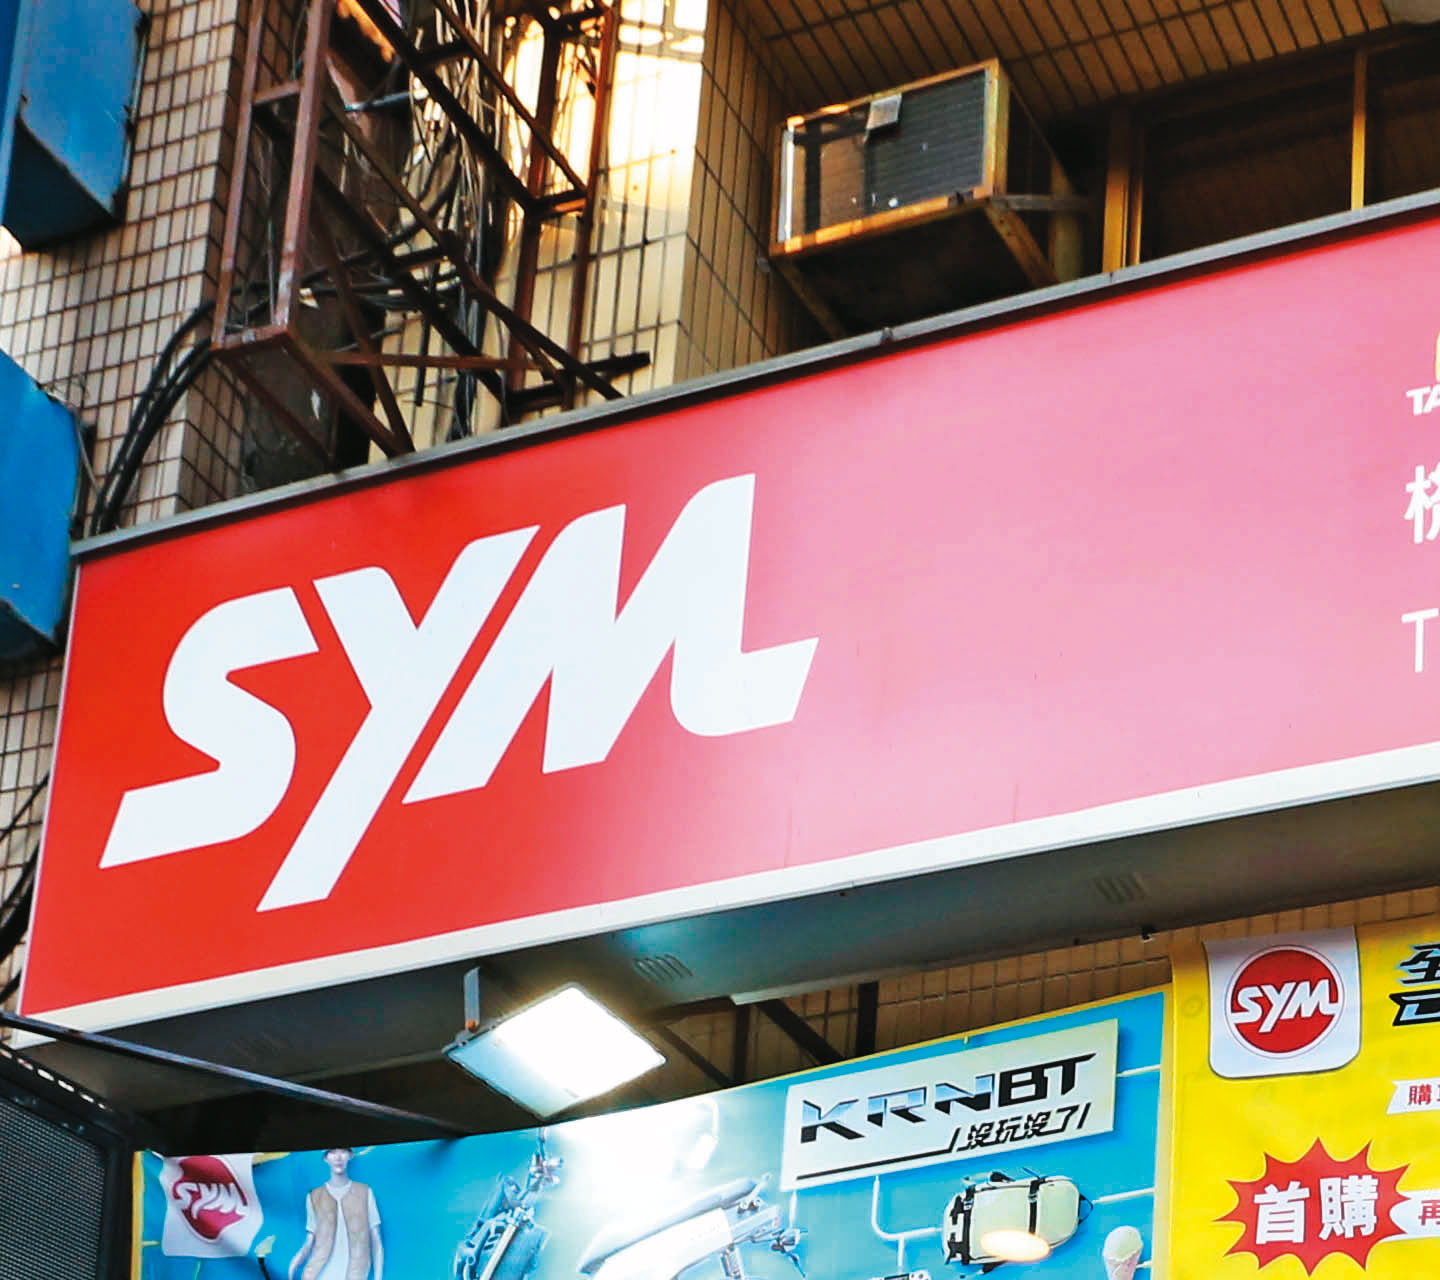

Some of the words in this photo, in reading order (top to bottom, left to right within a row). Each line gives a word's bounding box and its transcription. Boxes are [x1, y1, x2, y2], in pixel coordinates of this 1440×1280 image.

[100, 473, 819, 912] SYM
[1224, 976, 1342, 1037] SYM
[800, 1052, 1097, 1144] KRNBT
[172, 1181, 249, 1220] SYM
[1252, 1173, 1380, 1245] 首購
